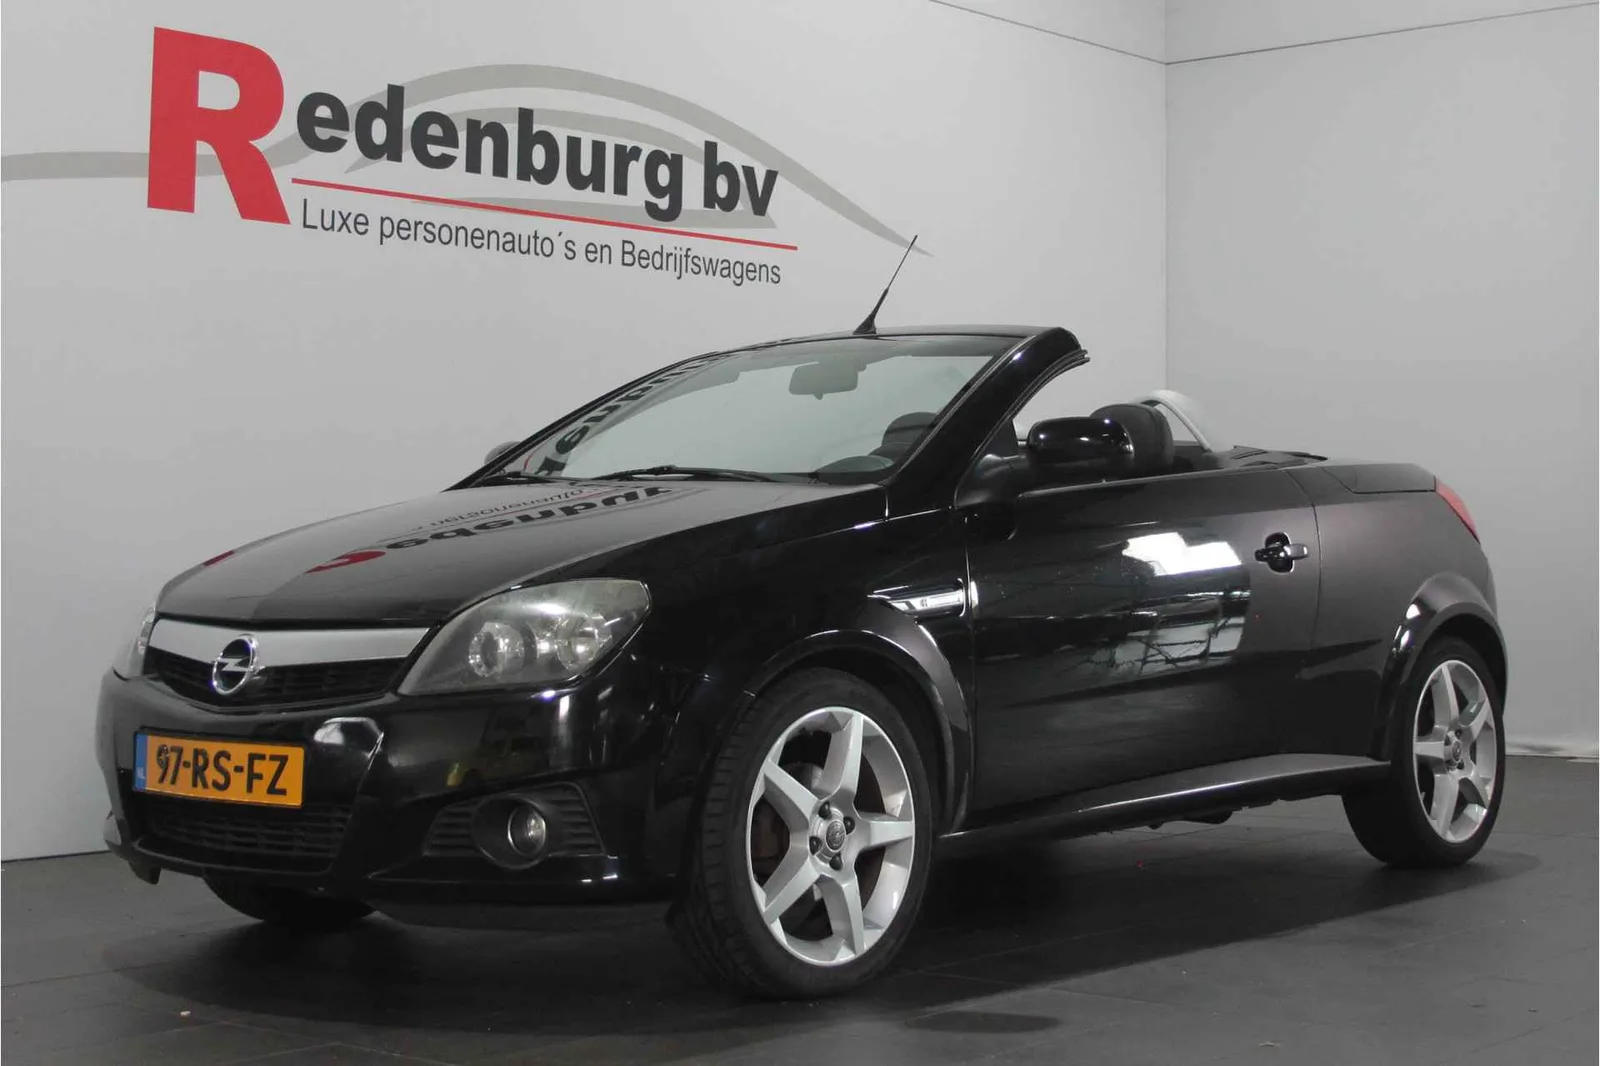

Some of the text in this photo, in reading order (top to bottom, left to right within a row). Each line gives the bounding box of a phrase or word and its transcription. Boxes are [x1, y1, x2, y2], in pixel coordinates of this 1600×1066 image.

[147, 26, 779, 225] Redenburg bv
[302, 198, 370, 236] Luxe
[584, 241, 612, 265] en
[621, 239, 782, 287] Bedrijfswagens
[156, 744, 289, 796] 97-RS-FZ
